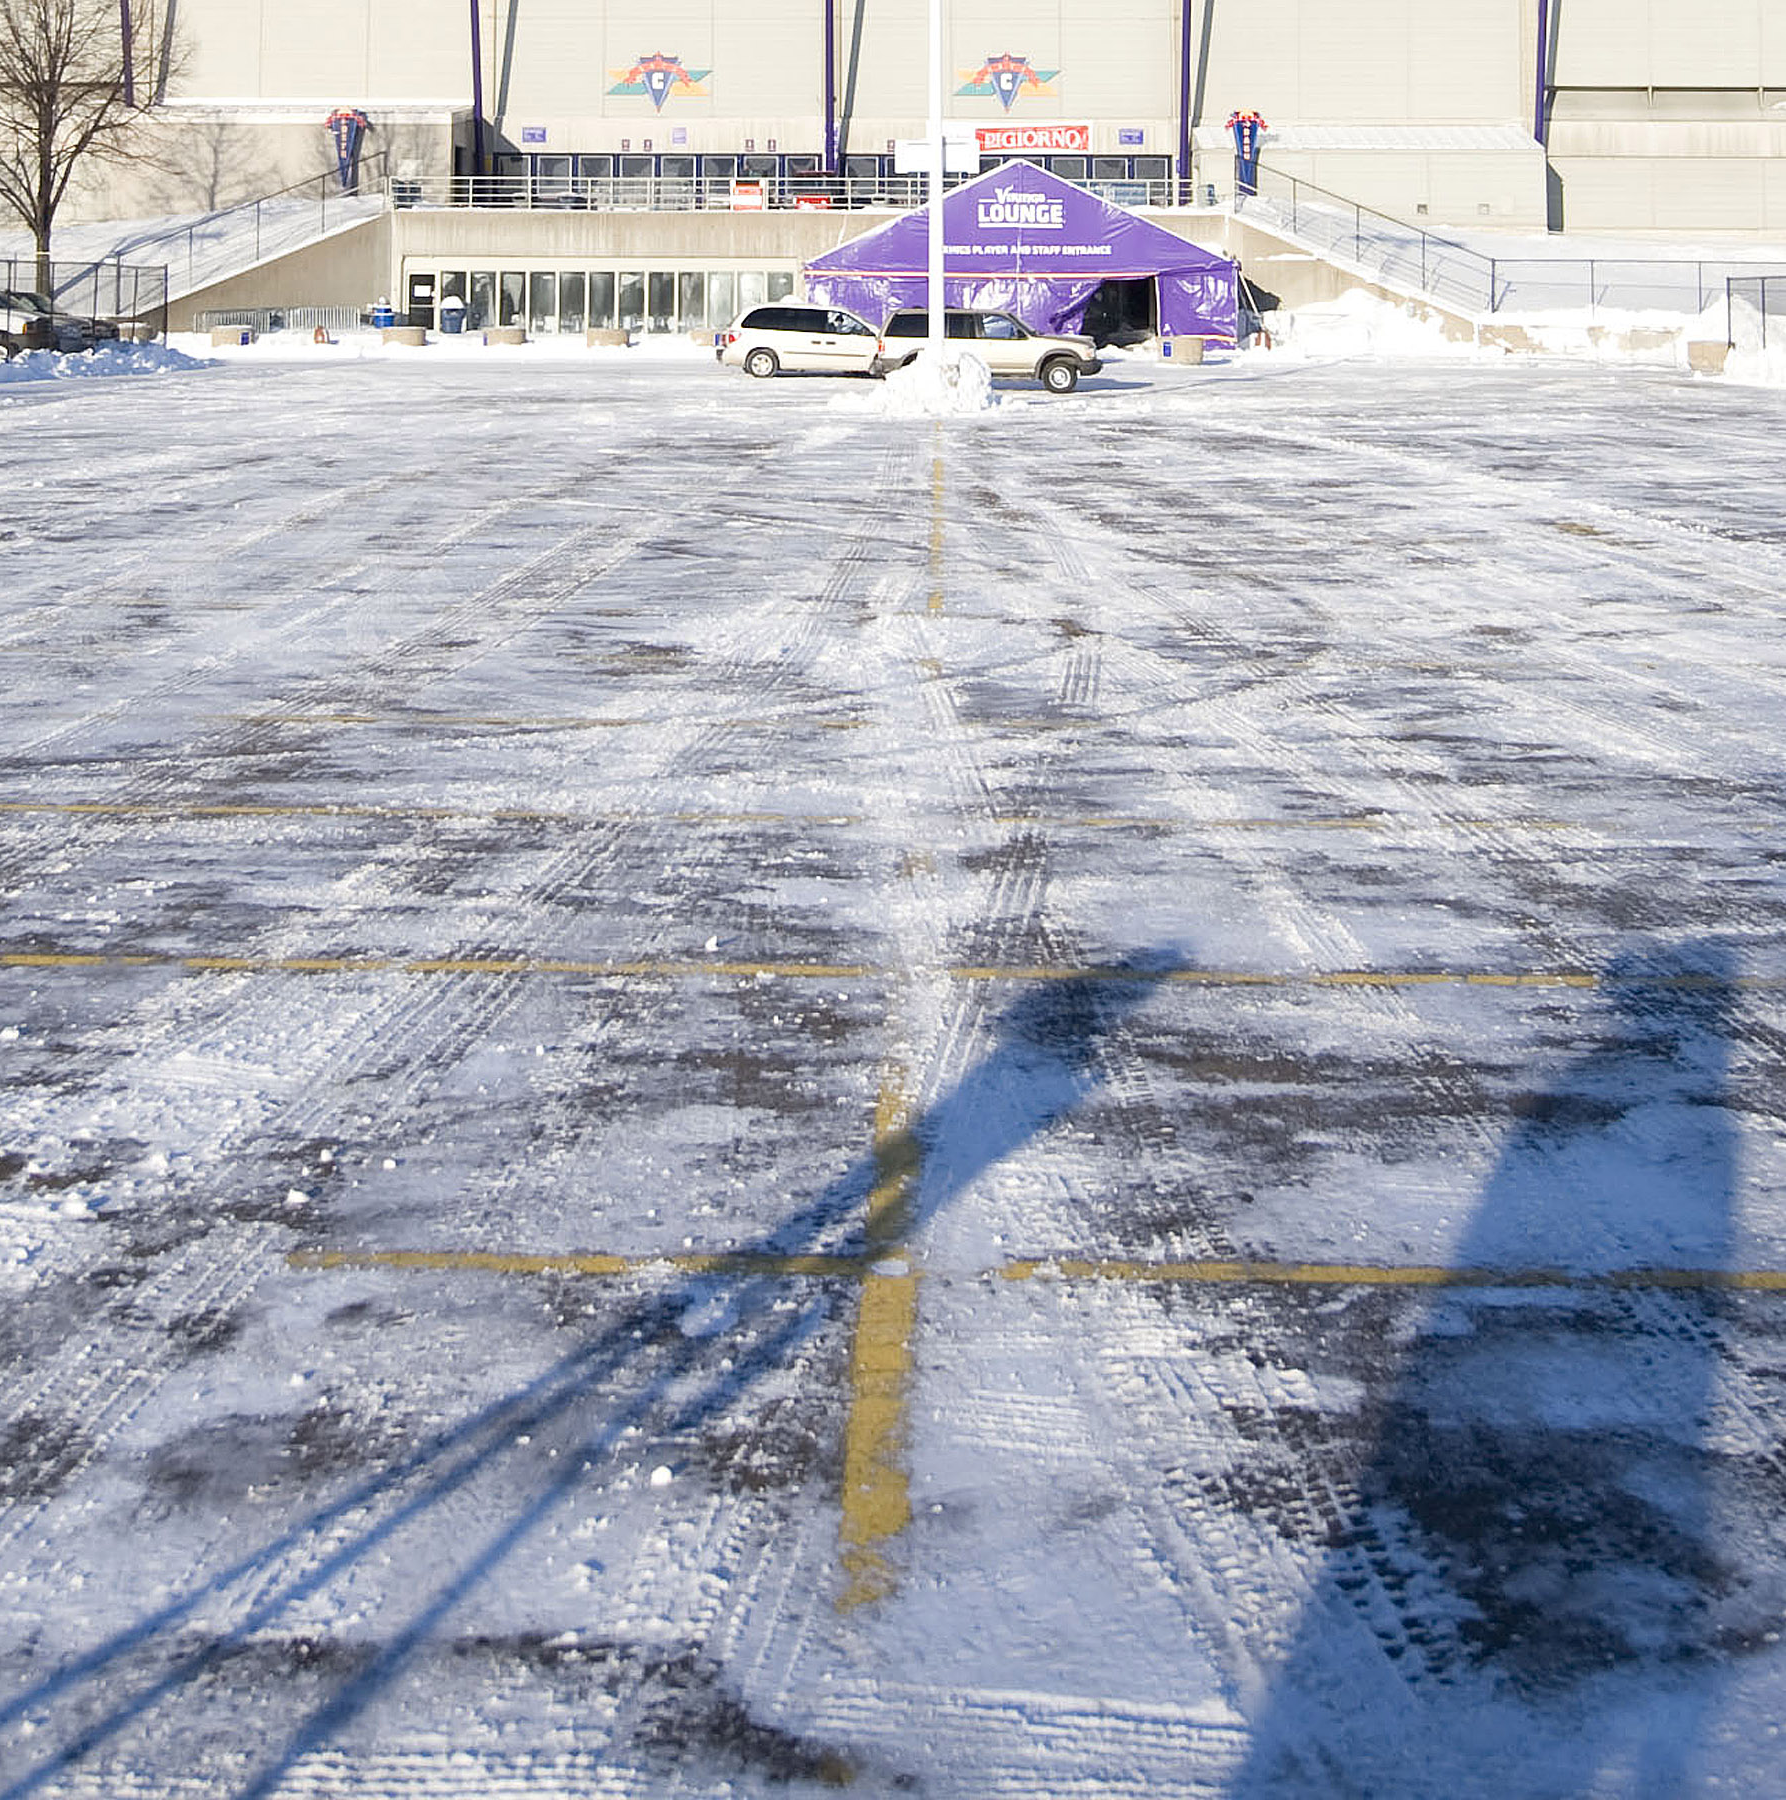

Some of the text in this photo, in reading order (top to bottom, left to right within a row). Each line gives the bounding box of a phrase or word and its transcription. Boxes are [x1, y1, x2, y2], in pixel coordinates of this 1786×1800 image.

[651, 71, 665, 90] C
[1000, 72, 1014, 91] C
[977, 203, 1064, 224] LOUNGE
